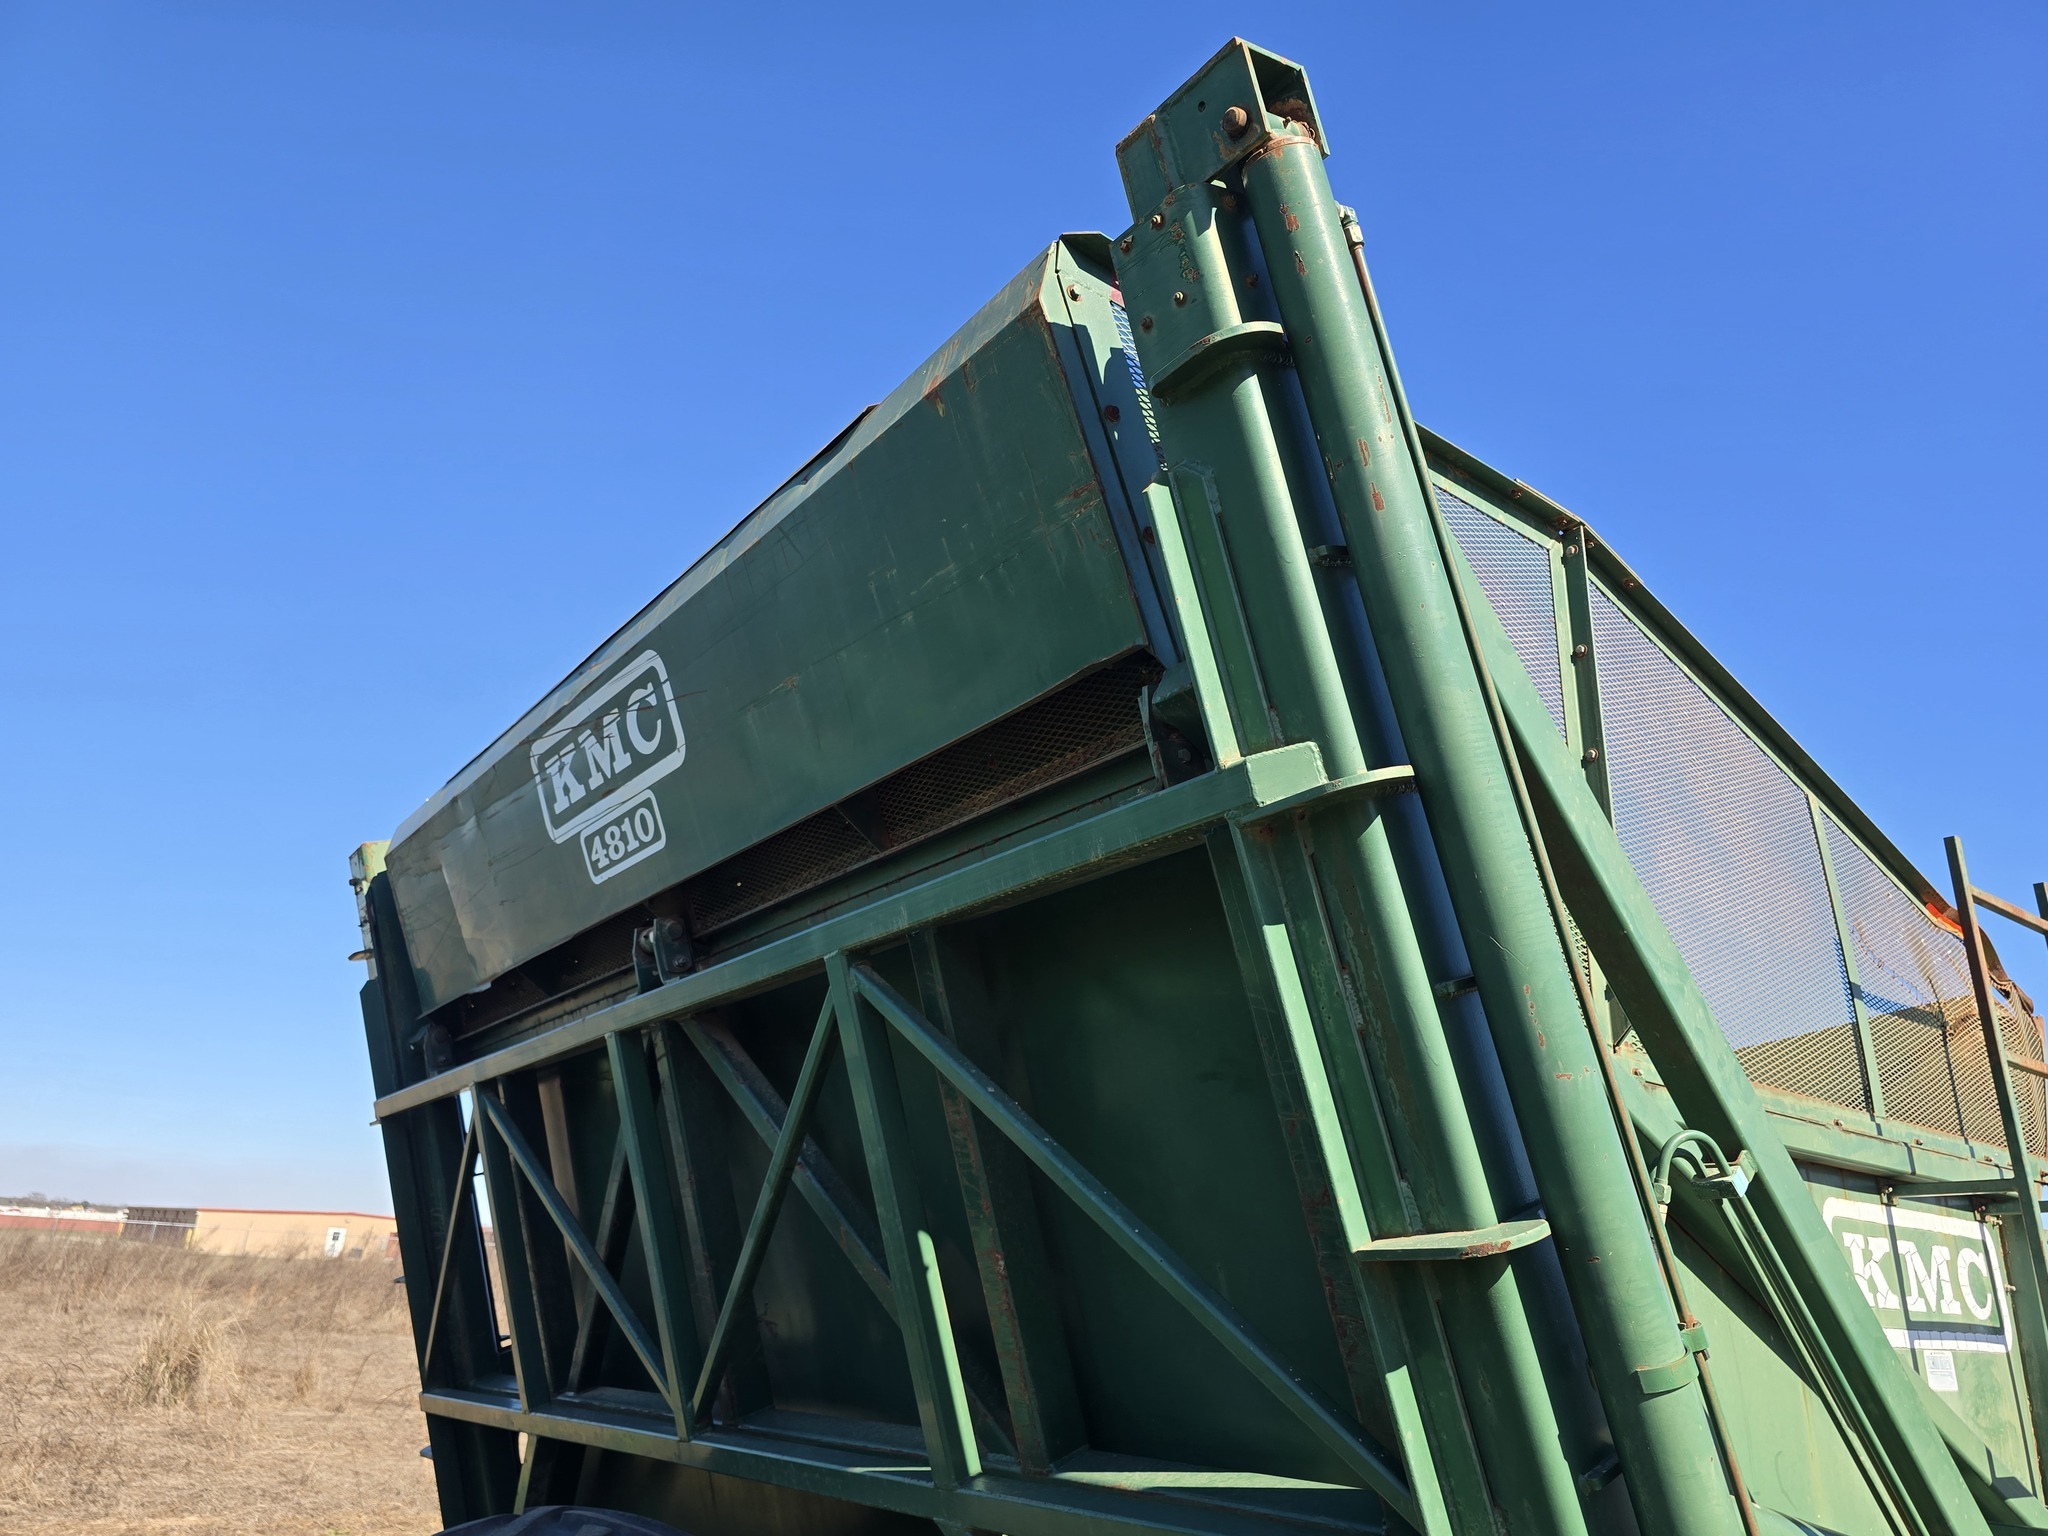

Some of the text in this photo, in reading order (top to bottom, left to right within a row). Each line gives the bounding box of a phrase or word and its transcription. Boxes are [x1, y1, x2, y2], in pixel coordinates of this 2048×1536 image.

[544, 682, 662, 815] KMC
[591, 807, 655, 869] 4810
[1842, 1232, 1993, 1321] KMC
